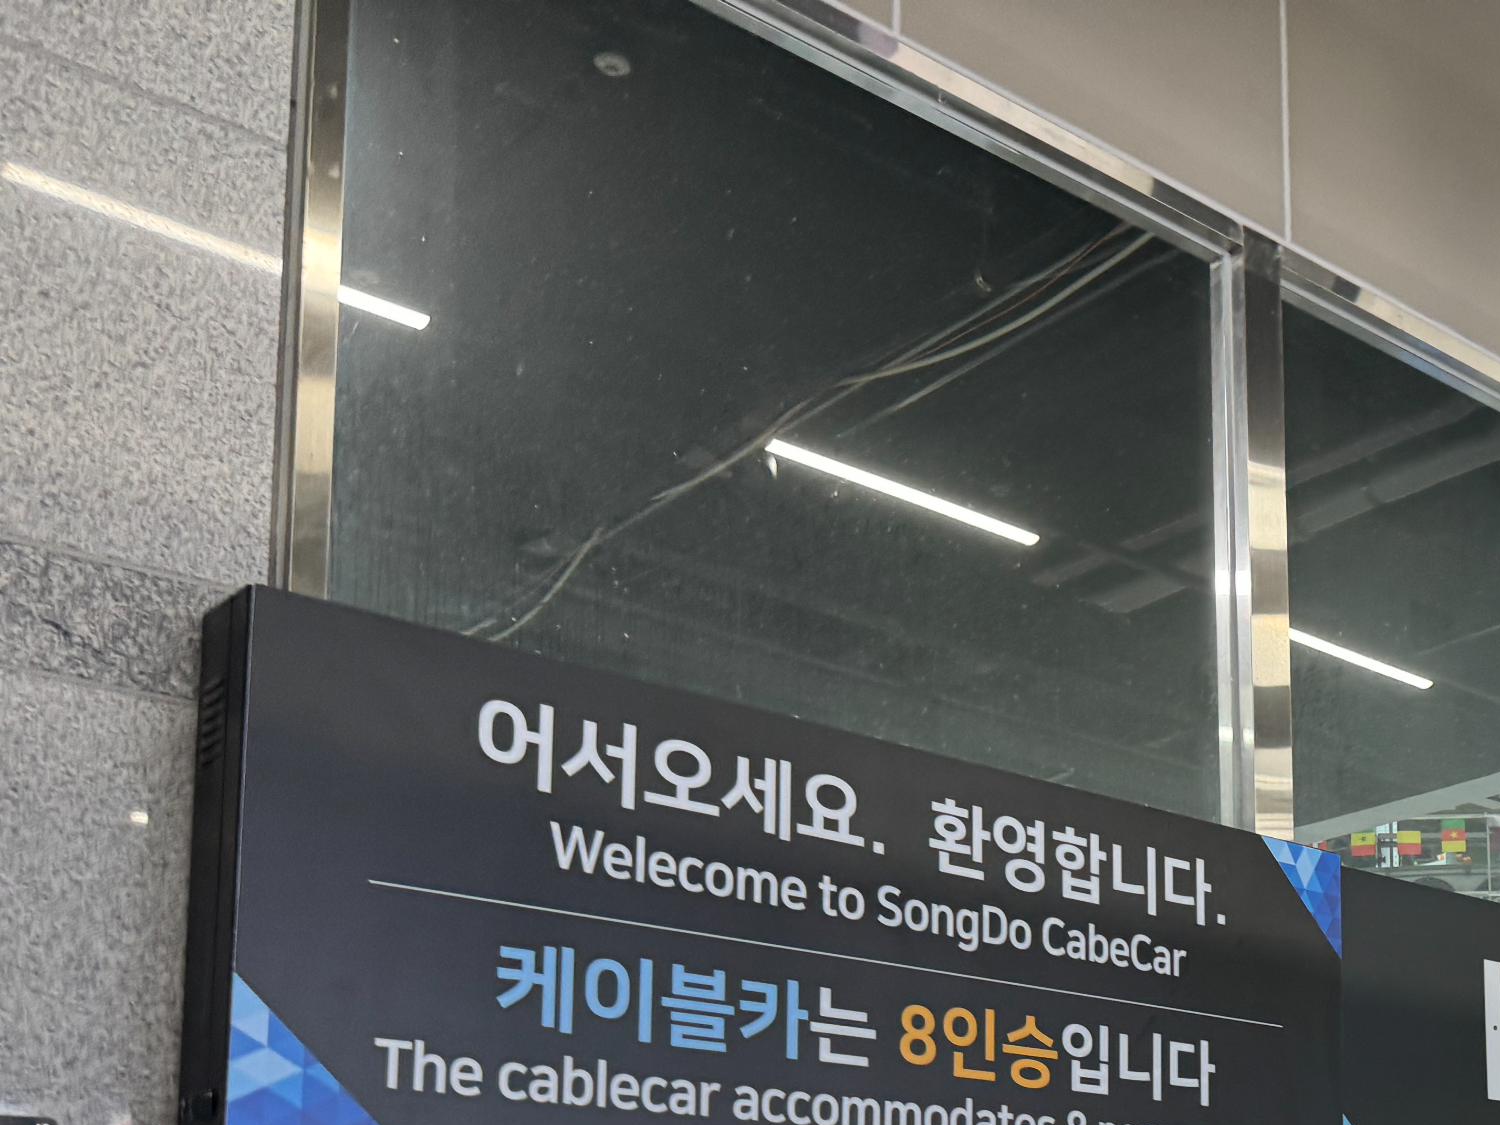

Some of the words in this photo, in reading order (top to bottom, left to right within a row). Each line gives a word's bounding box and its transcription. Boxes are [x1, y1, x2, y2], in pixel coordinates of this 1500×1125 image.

[479, 700, 884, 858] 어서오세요.
[929, 793, 1229, 931] 환영합니다.
[544, 818, 810, 919] Welecome
[819, 875, 864, 920] to
[878, 881, 1035, 951] SongDo
[1043, 911, 1186, 976] CabeCar
[375, 1038, 482, 1096] The
[499, 1056, 720, 1116] cablecar
[497, 940, 880, 1073] 케이블카는
[893, 998, 1220, 1114] 8인승입니다
